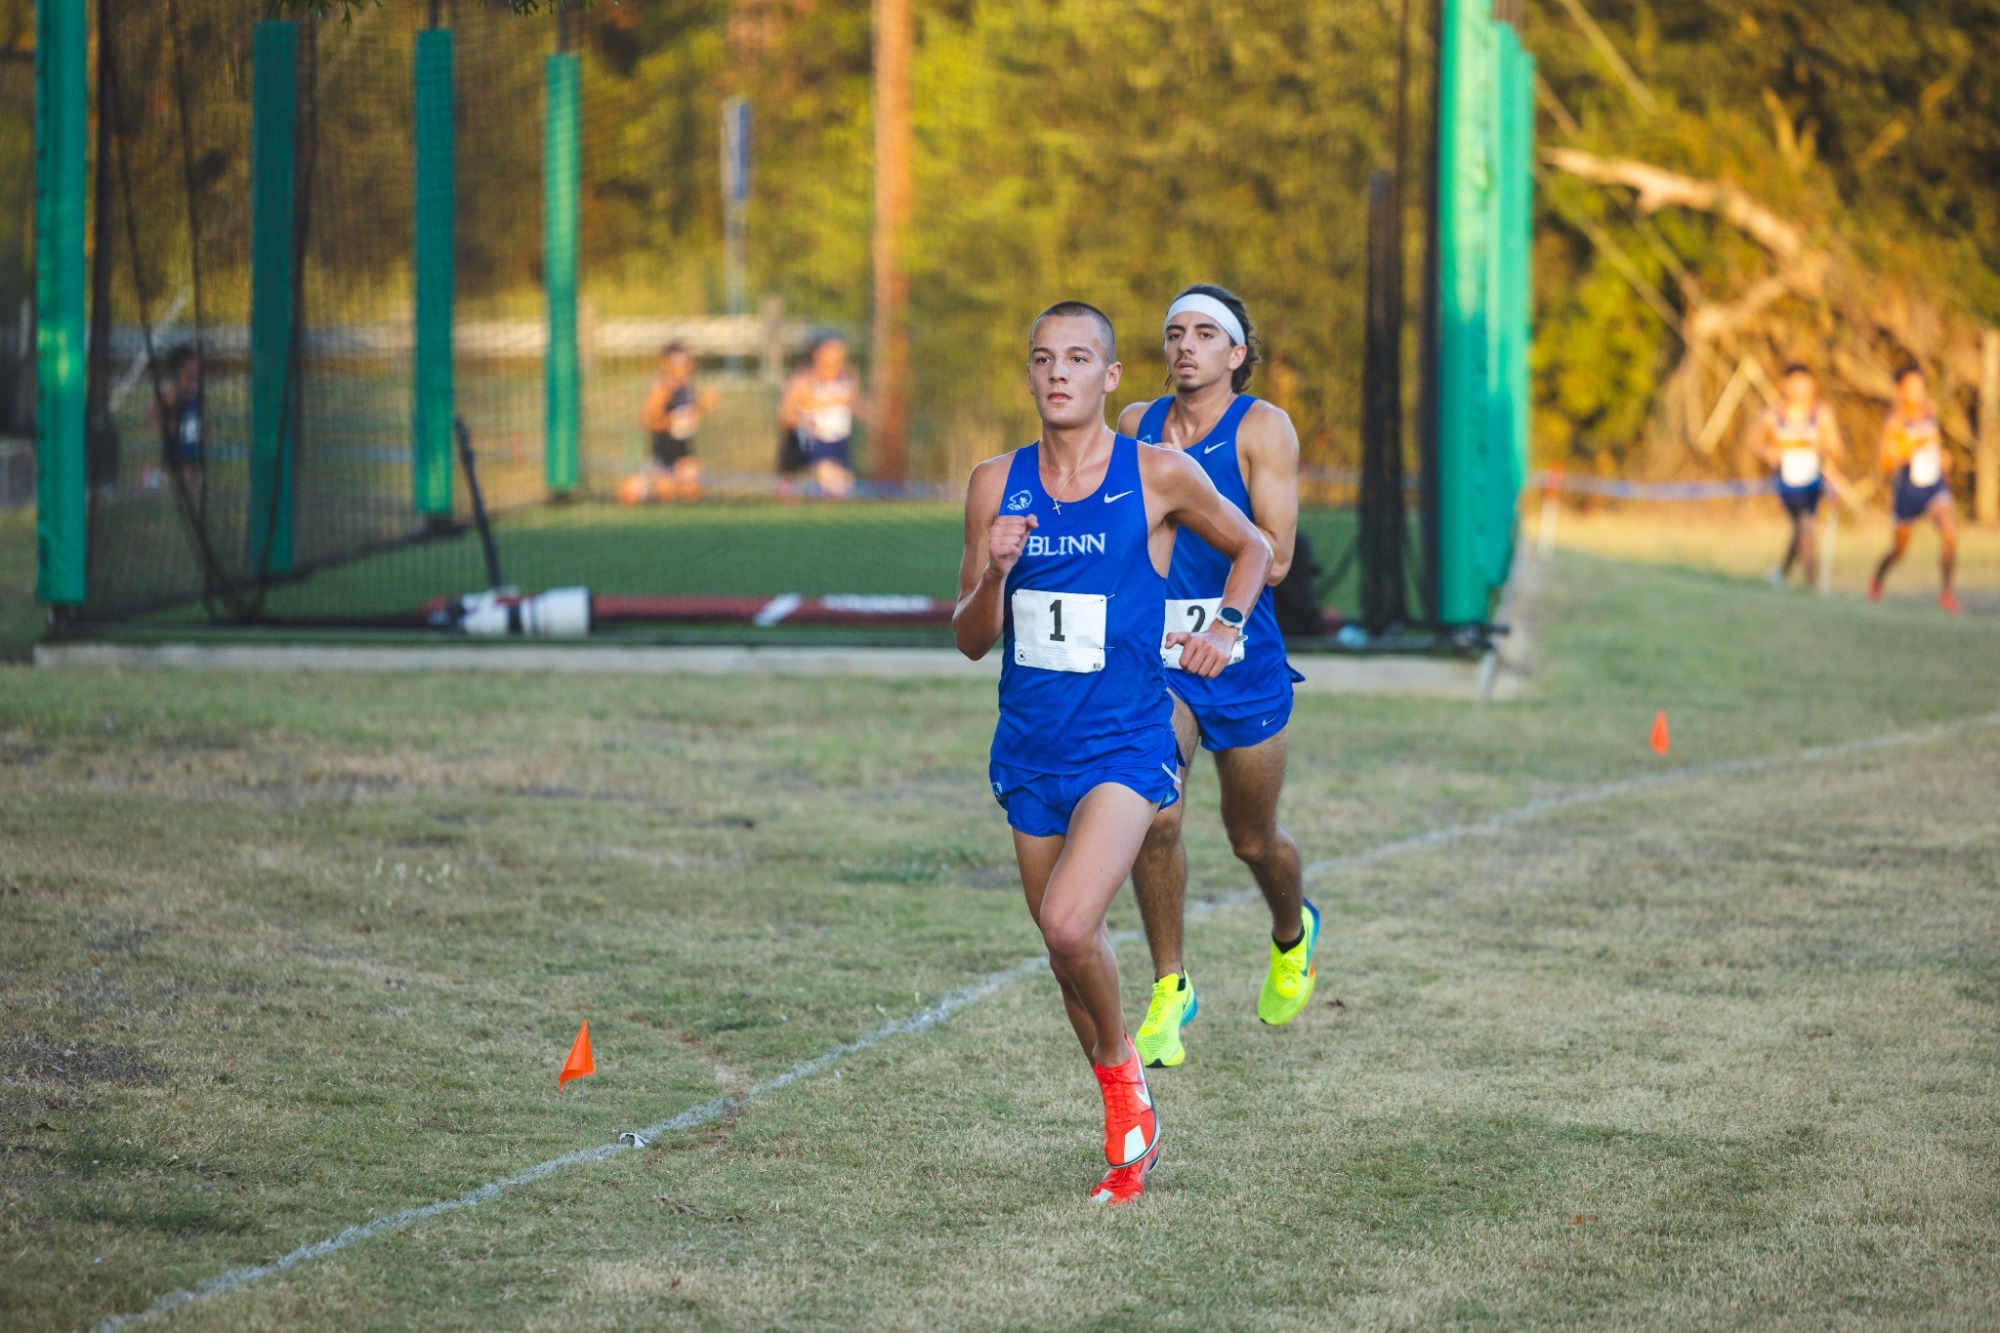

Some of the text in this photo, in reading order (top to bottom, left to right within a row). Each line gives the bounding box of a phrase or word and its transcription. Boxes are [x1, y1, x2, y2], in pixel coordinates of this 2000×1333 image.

[1027, 532, 1106, 556] BLINN
[1050, 599, 1065, 642] 1
[1187, 604, 1206, 633] 2
